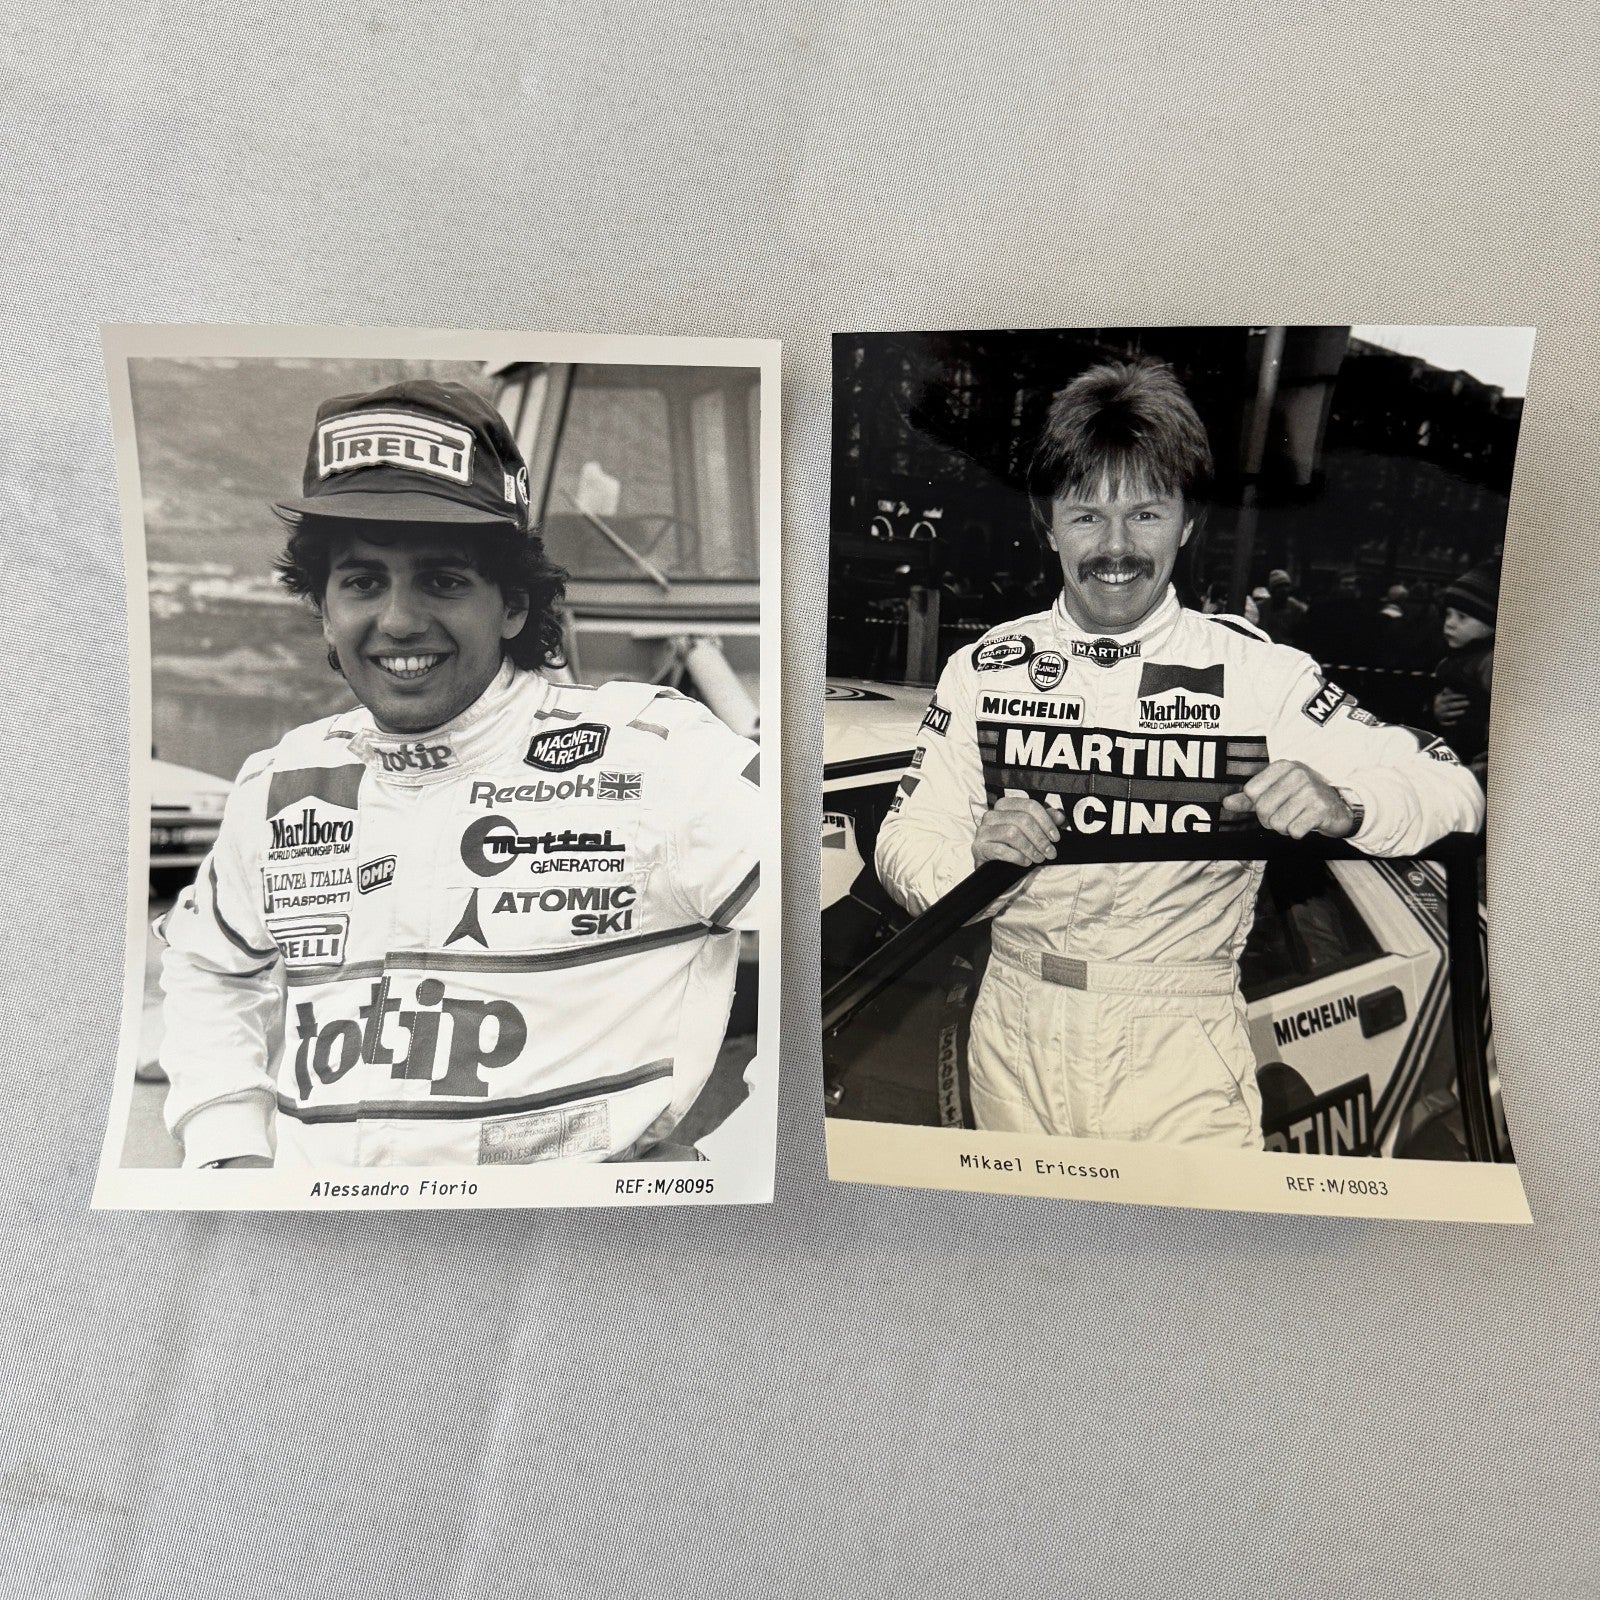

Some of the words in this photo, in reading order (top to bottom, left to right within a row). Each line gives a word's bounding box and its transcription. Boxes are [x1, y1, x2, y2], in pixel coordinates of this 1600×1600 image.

[324, 422, 465, 473] PIRELLI
[981, 646, 1022, 659] MARTINI
[1076, 643, 1139, 658] MARTINI
[982, 696, 1081, 721] MICHELIN
[1139, 695, 1221, 721] Marlboro
[1138, 721, 1158, 730] WORLD
[1159, 721, 1202, 730] CHAMPIONSHIP
[1203, 721, 1220, 730] TEAM
[533, 741, 599, 765] MARELLI
[535, 729, 602, 752] MAGNETI
[1004, 728, 1217, 779] MARTINI
[373, 743, 453, 772] totip
[469, 774, 596, 809] Reebok
[1004, 788, 1213, 835] ACING
[269, 808, 354, 850] Marlboro
[268, 849, 290, 861] WORLD
[291, 846, 333, 859] CHAMPIONSHIP
[333, 844, 351, 855] TEAM
[361, 860, 395, 887] OMP
[530, 858, 625, 874] GENERATORI
[273, 872, 307, 892] LINEA
[310, 867, 354, 888] ITALIA
[274, 891, 351, 909] TRASPORTI
[492, 885, 637, 914] ATOMIC
[571, 909, 633, 936] SKI
[276, 932, 341, 959] RELLI
[1273, 995, 1357, 1047] MICHELIN
[295, 975, 528, 1101] totip
[960, 1154, 1023, 1173] Mikael
[1035, 1159, 1120, 1180] Ericsson
[311, 1181, 409, 1197] Alessandro
[419, 1181, 478, 1197] Fiorio
[615, 1178, 715, 1196] REF:M/8095
[1286, 1176, 1389, 1196] REF:M/8083
